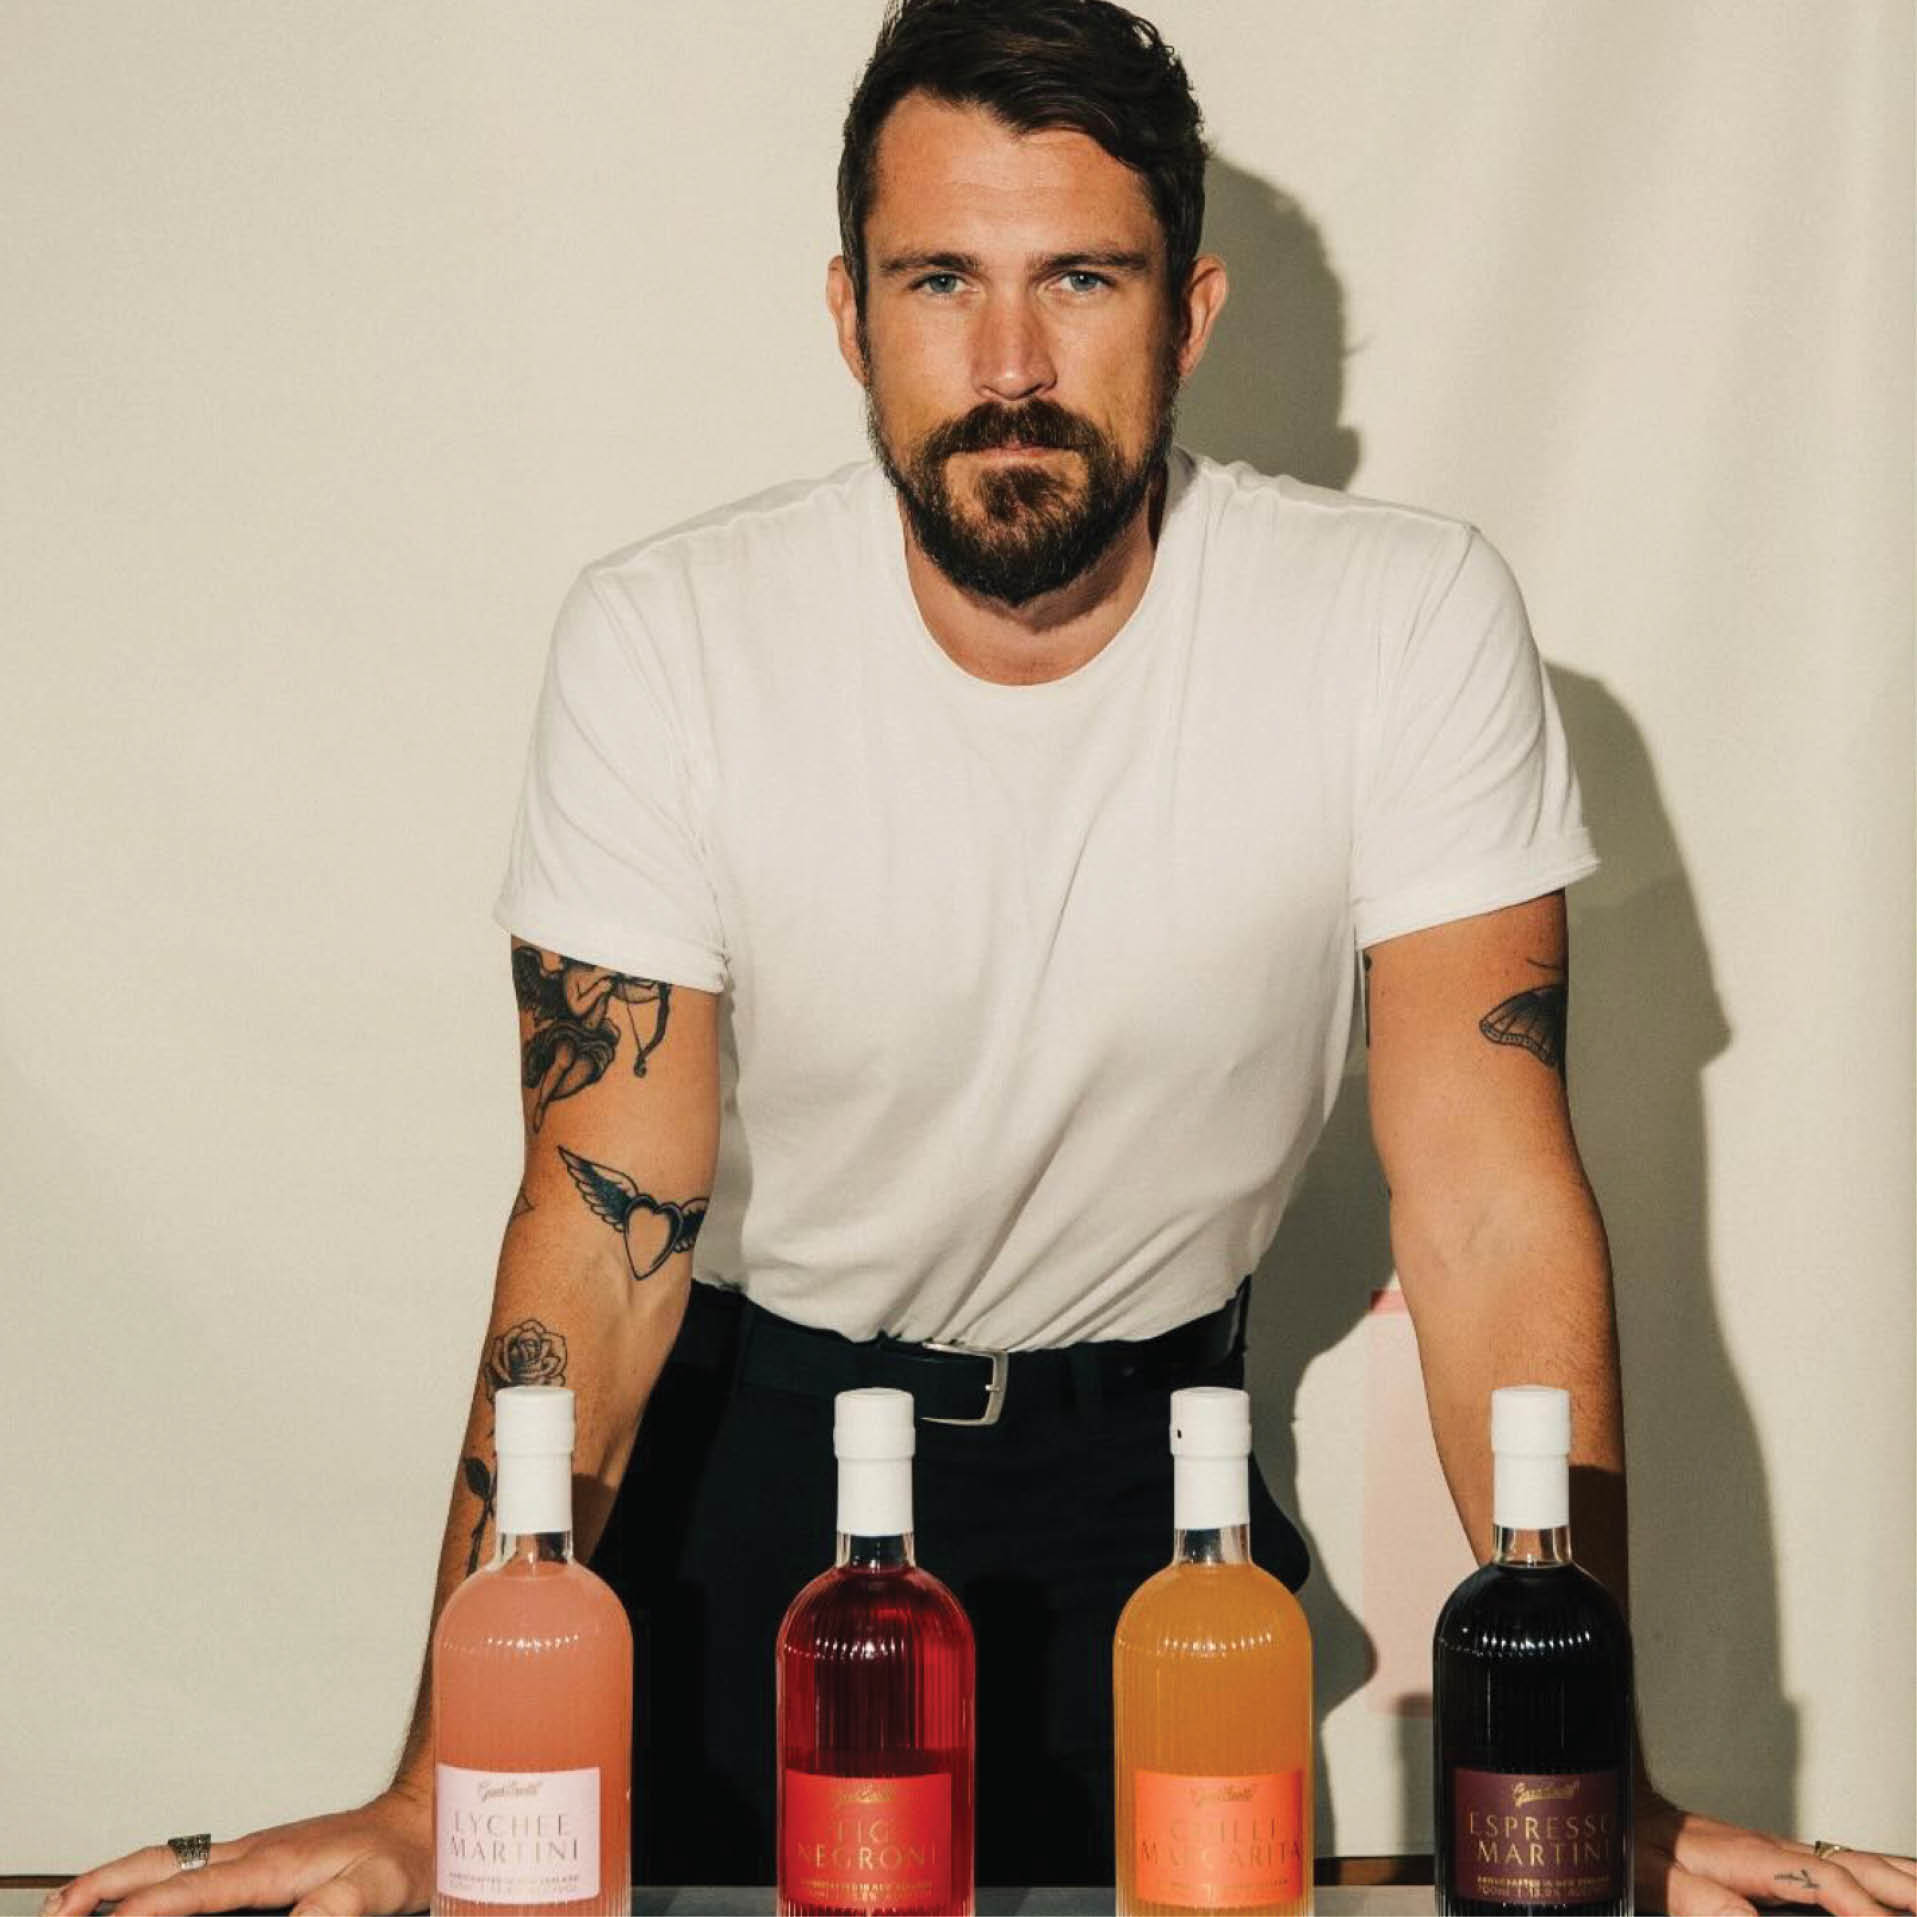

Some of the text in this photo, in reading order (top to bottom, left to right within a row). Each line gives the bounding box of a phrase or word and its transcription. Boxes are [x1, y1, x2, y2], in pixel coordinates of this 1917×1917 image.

[453, 1809, 571, 1838] LYCHEE
[449, 1835, 579, 1865] MARTINI
[797, 1842, 937, 1870] NEGRONI
[1477, 1839, 1609, 1867] MARTINI
